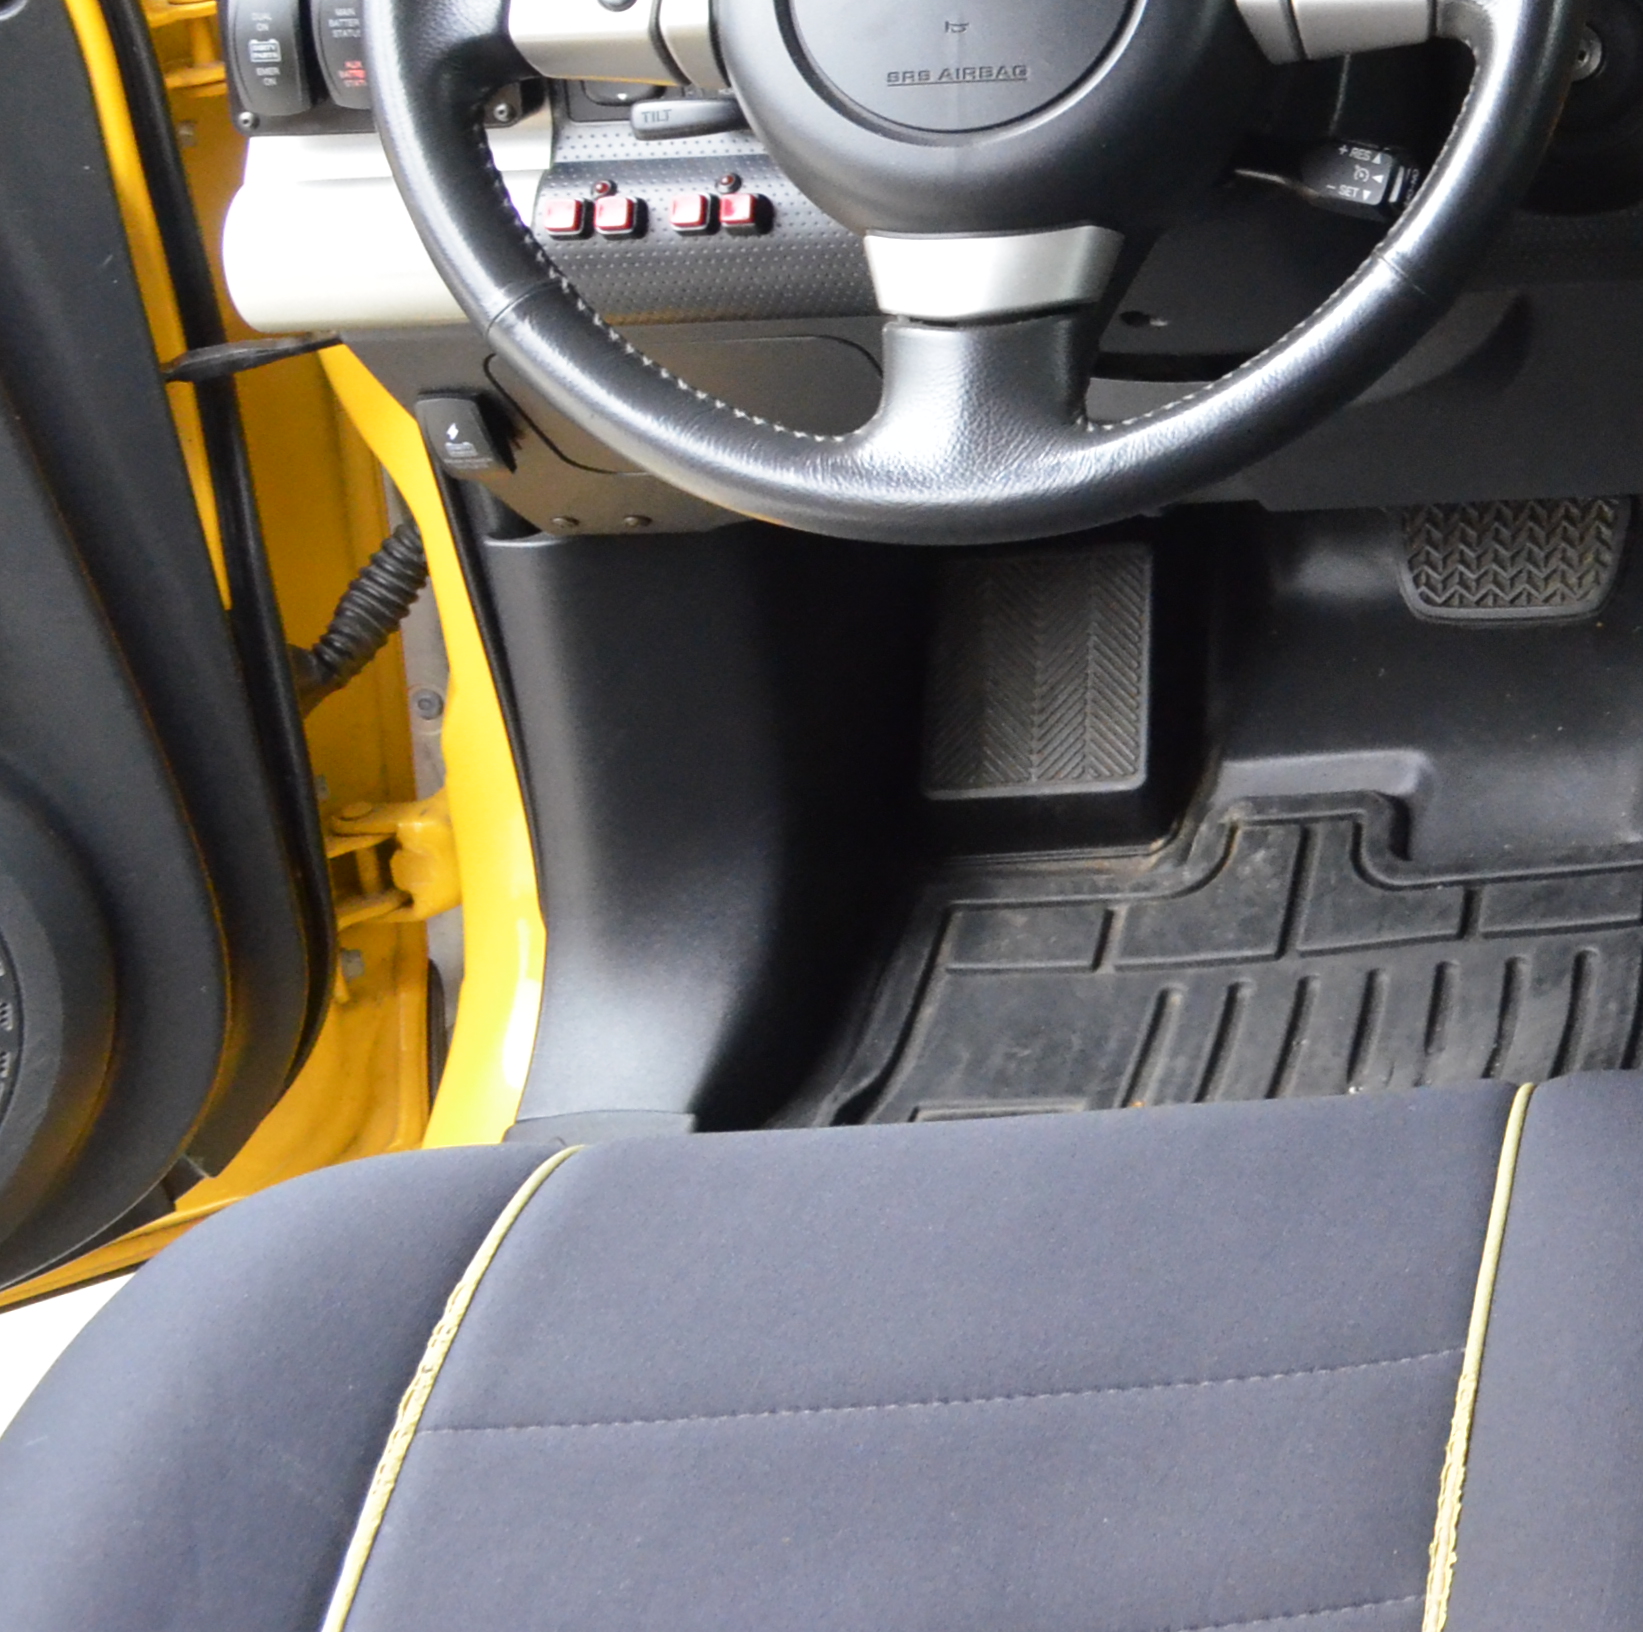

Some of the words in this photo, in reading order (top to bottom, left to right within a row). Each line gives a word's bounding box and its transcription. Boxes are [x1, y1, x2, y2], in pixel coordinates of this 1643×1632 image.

[938, 64, 1028, 82] AIRBAG
[641, 108, 672, 124] TILT
[1349, 147, 1372, 161] RES
[1338, 184, 1360, 198] SET
